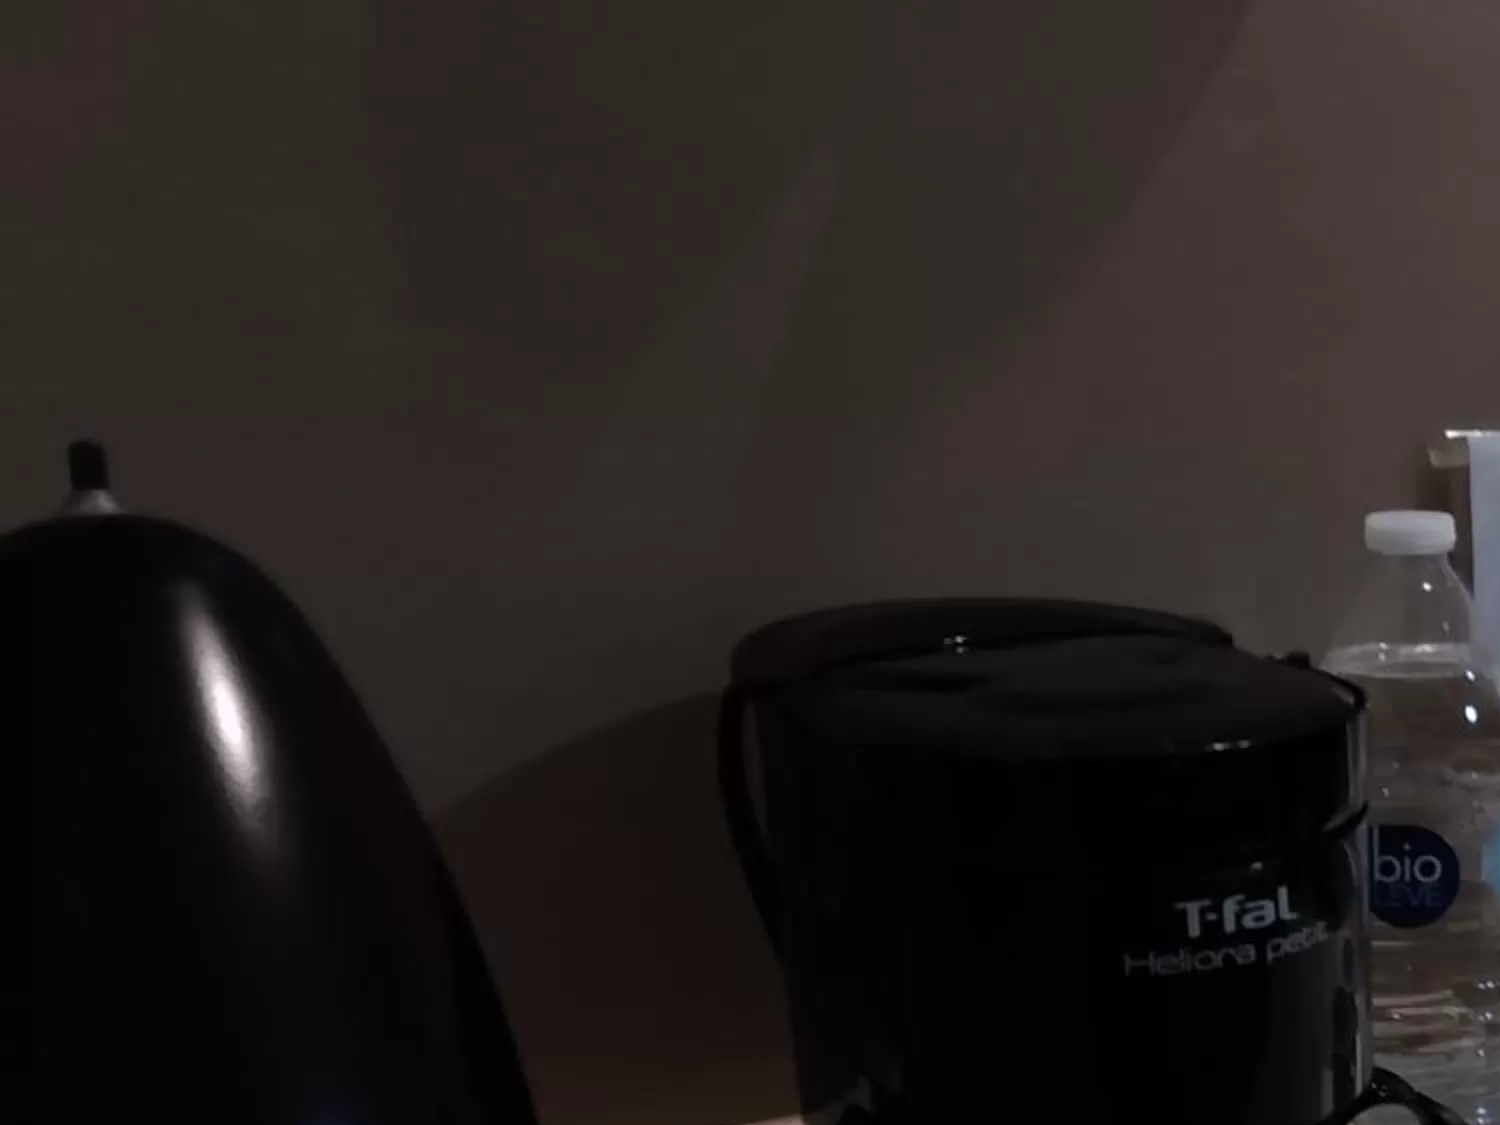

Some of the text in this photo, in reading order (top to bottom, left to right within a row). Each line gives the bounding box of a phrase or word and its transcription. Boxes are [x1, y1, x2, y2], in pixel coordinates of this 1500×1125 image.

[1373, 824, 1443, 883] bio
[1171, 884, 1299, 940] T-fal
[1122, 942, 1257, 978] Heliora
